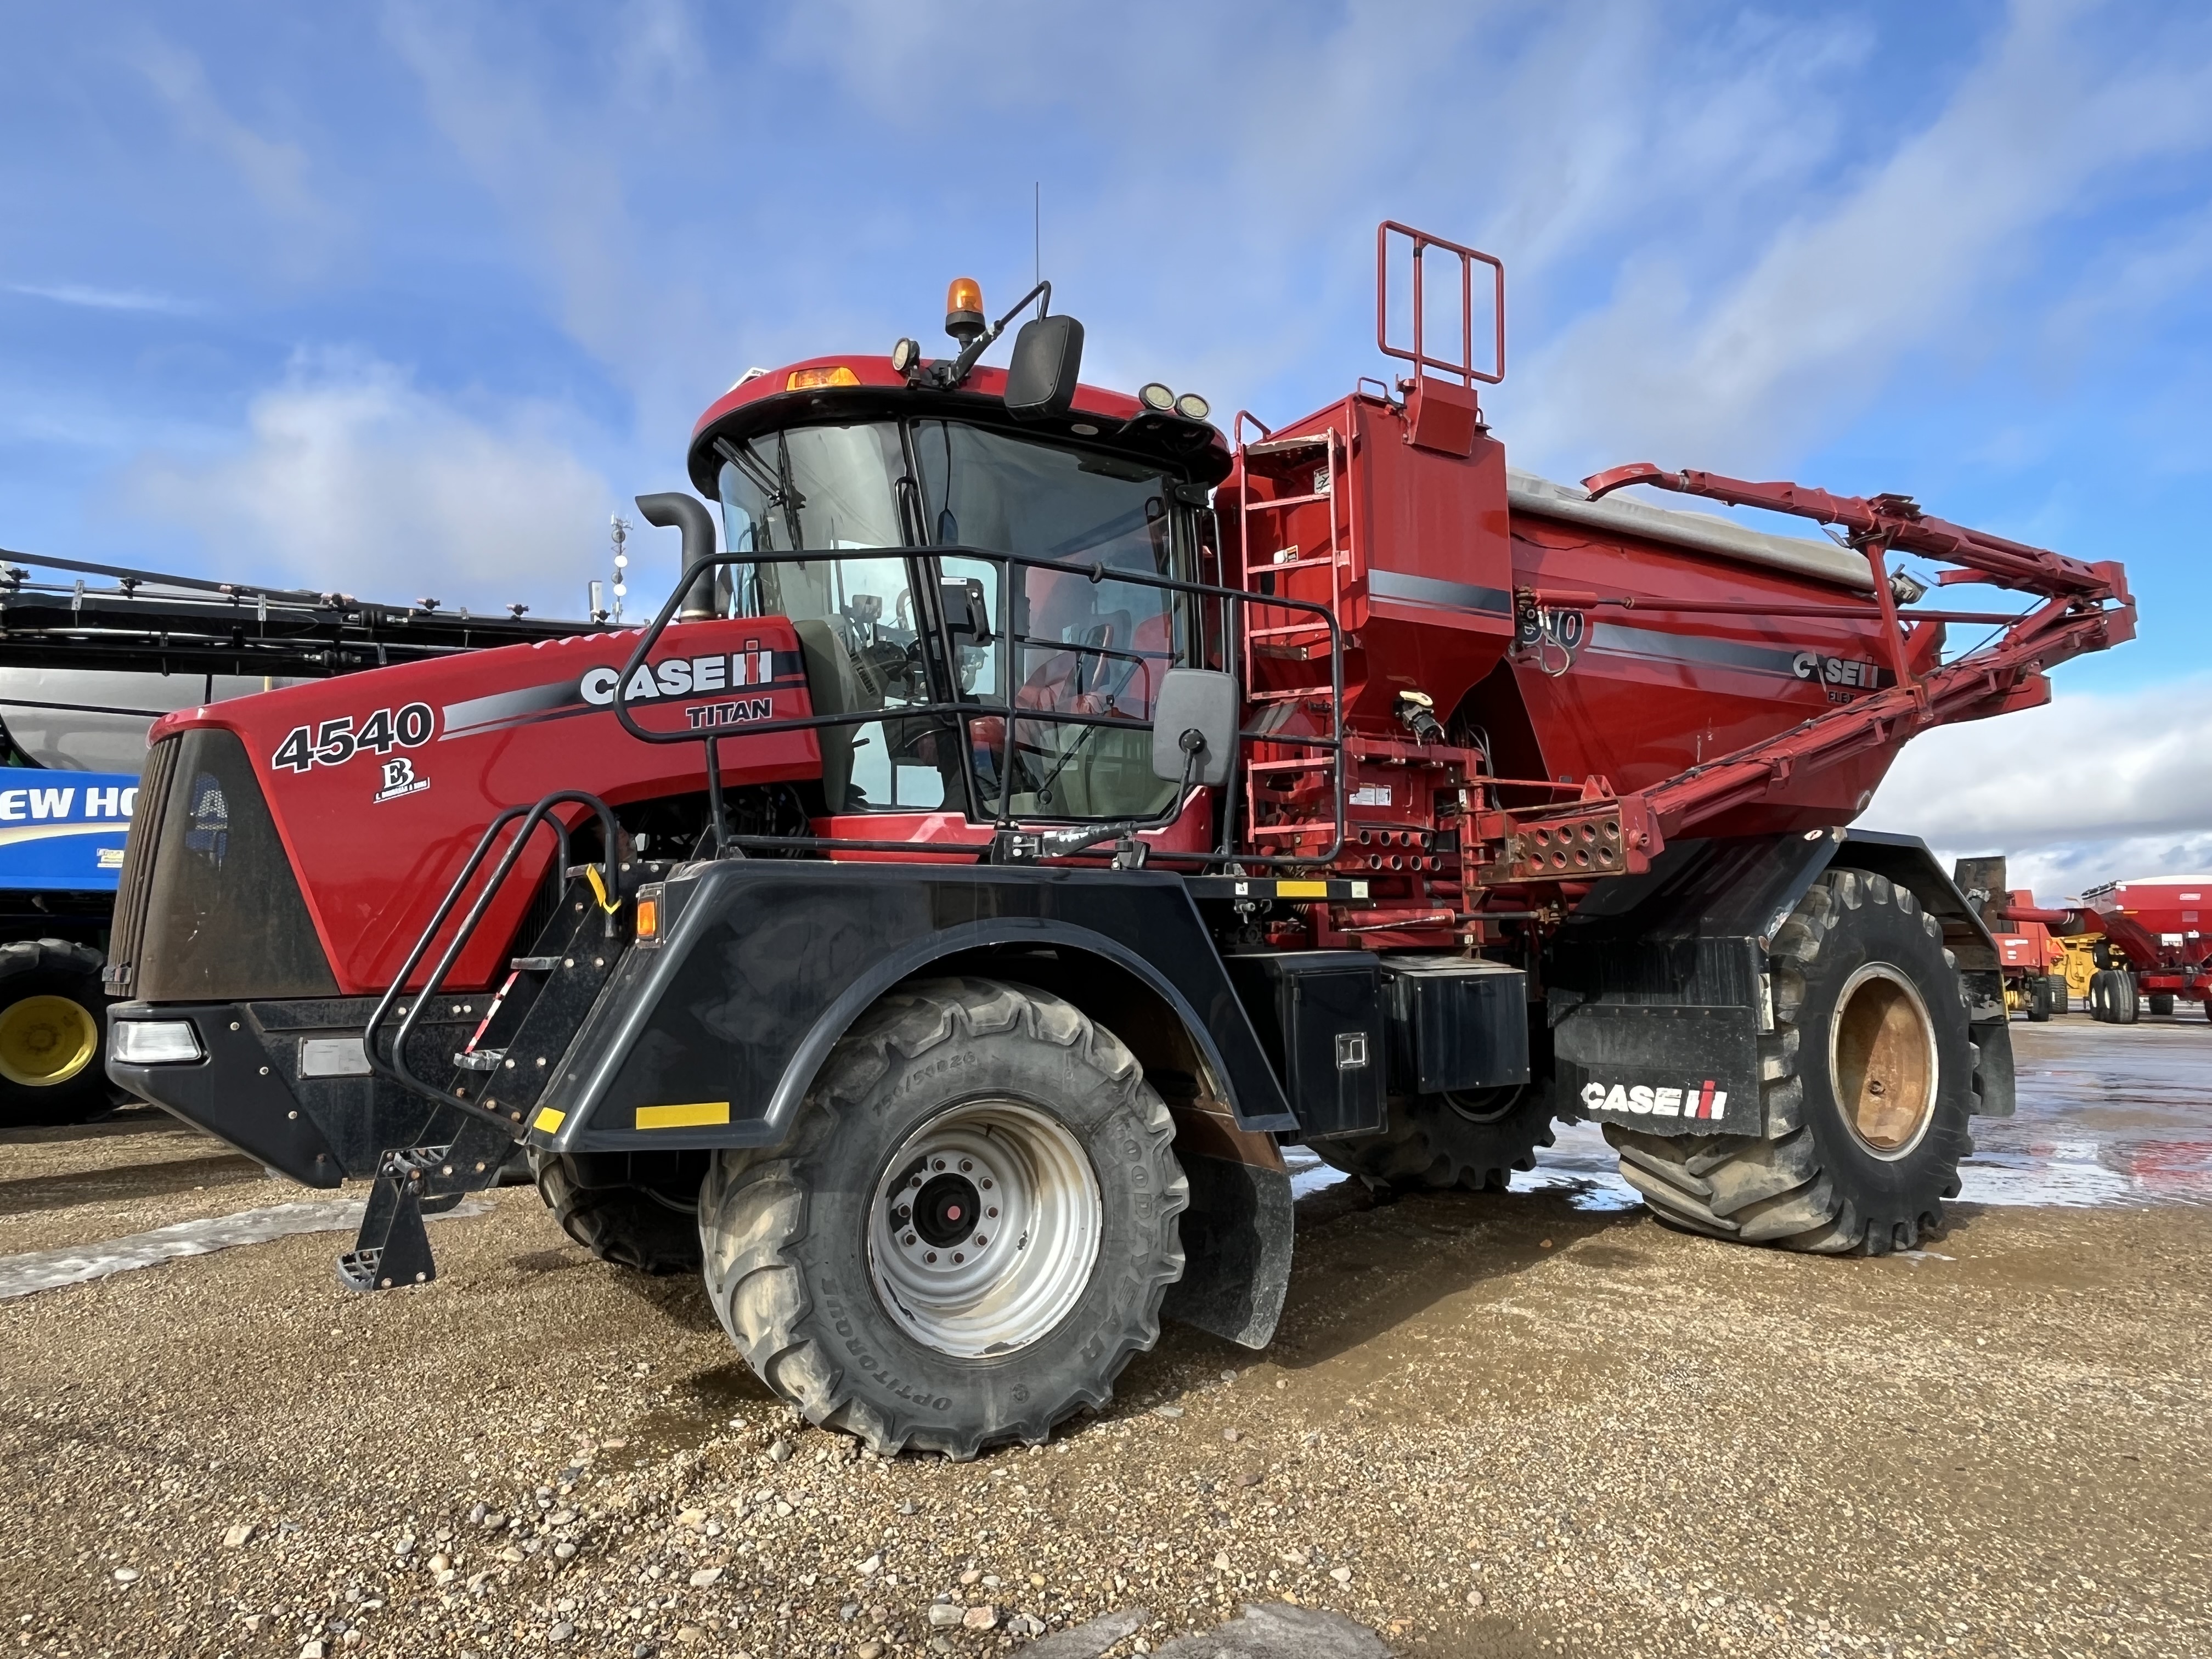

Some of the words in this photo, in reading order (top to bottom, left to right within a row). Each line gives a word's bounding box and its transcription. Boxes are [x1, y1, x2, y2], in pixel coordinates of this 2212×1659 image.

[580, 655, 725, 706] CASE
[1793, 653, 1860, 685] CSE
[685, 698, 772, 729] TITAN
[272, 702, 435, 774] 4540
[1581, 1082, 1683, 1116] CASE
